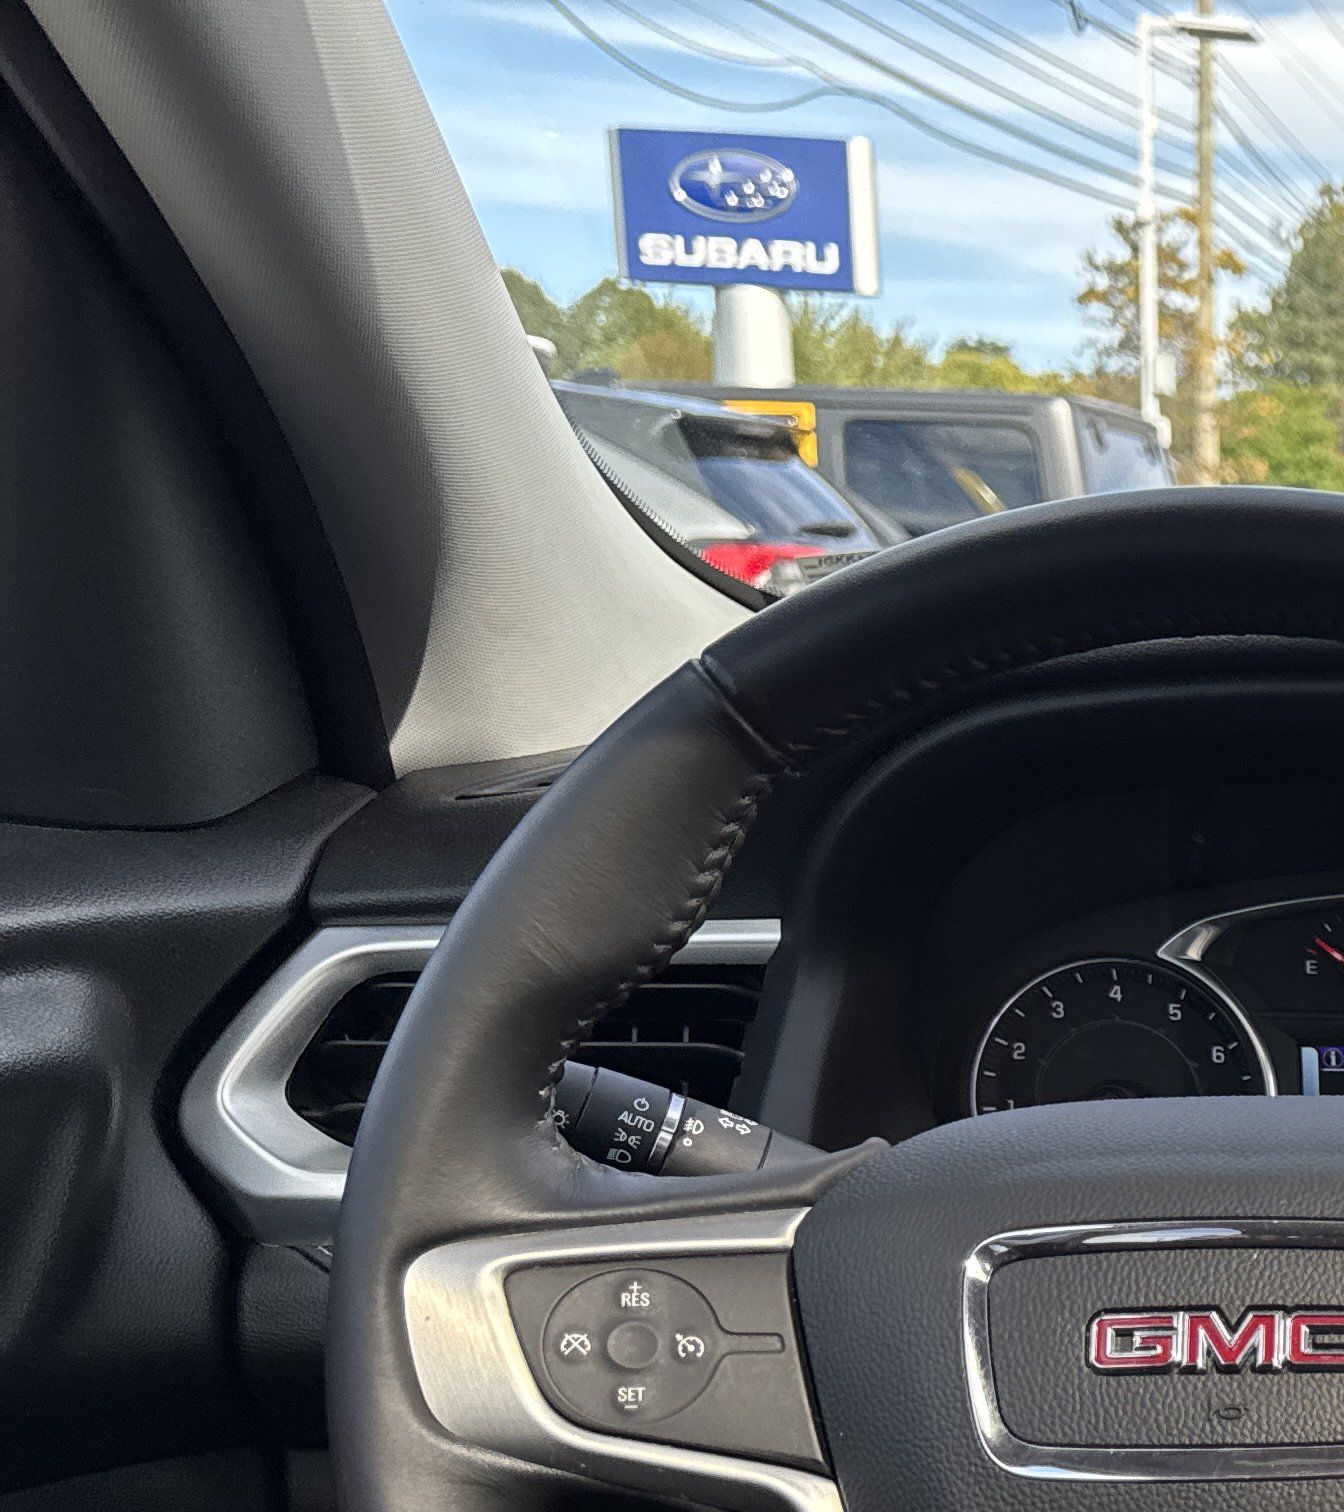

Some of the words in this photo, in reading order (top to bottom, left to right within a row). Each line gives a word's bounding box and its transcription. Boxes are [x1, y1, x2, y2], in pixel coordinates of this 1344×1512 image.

[638, 232, 840, 275] SUBARU
[1305, 960, 1318, 975] E
[1109, 985, 1123, 1002] 4
[1051, 1000, 1065, 1019] 3
[1168, 1003, 1182, 1021] 5
[1012, 1042, 1026, 1060] 2
[1211, 1045, 1225, 1064] 6
[618, 1110, 655, 1133] AUTO
[621, 1292, 650, 1308] RES
[617, 1386, 646, 1402] SET
